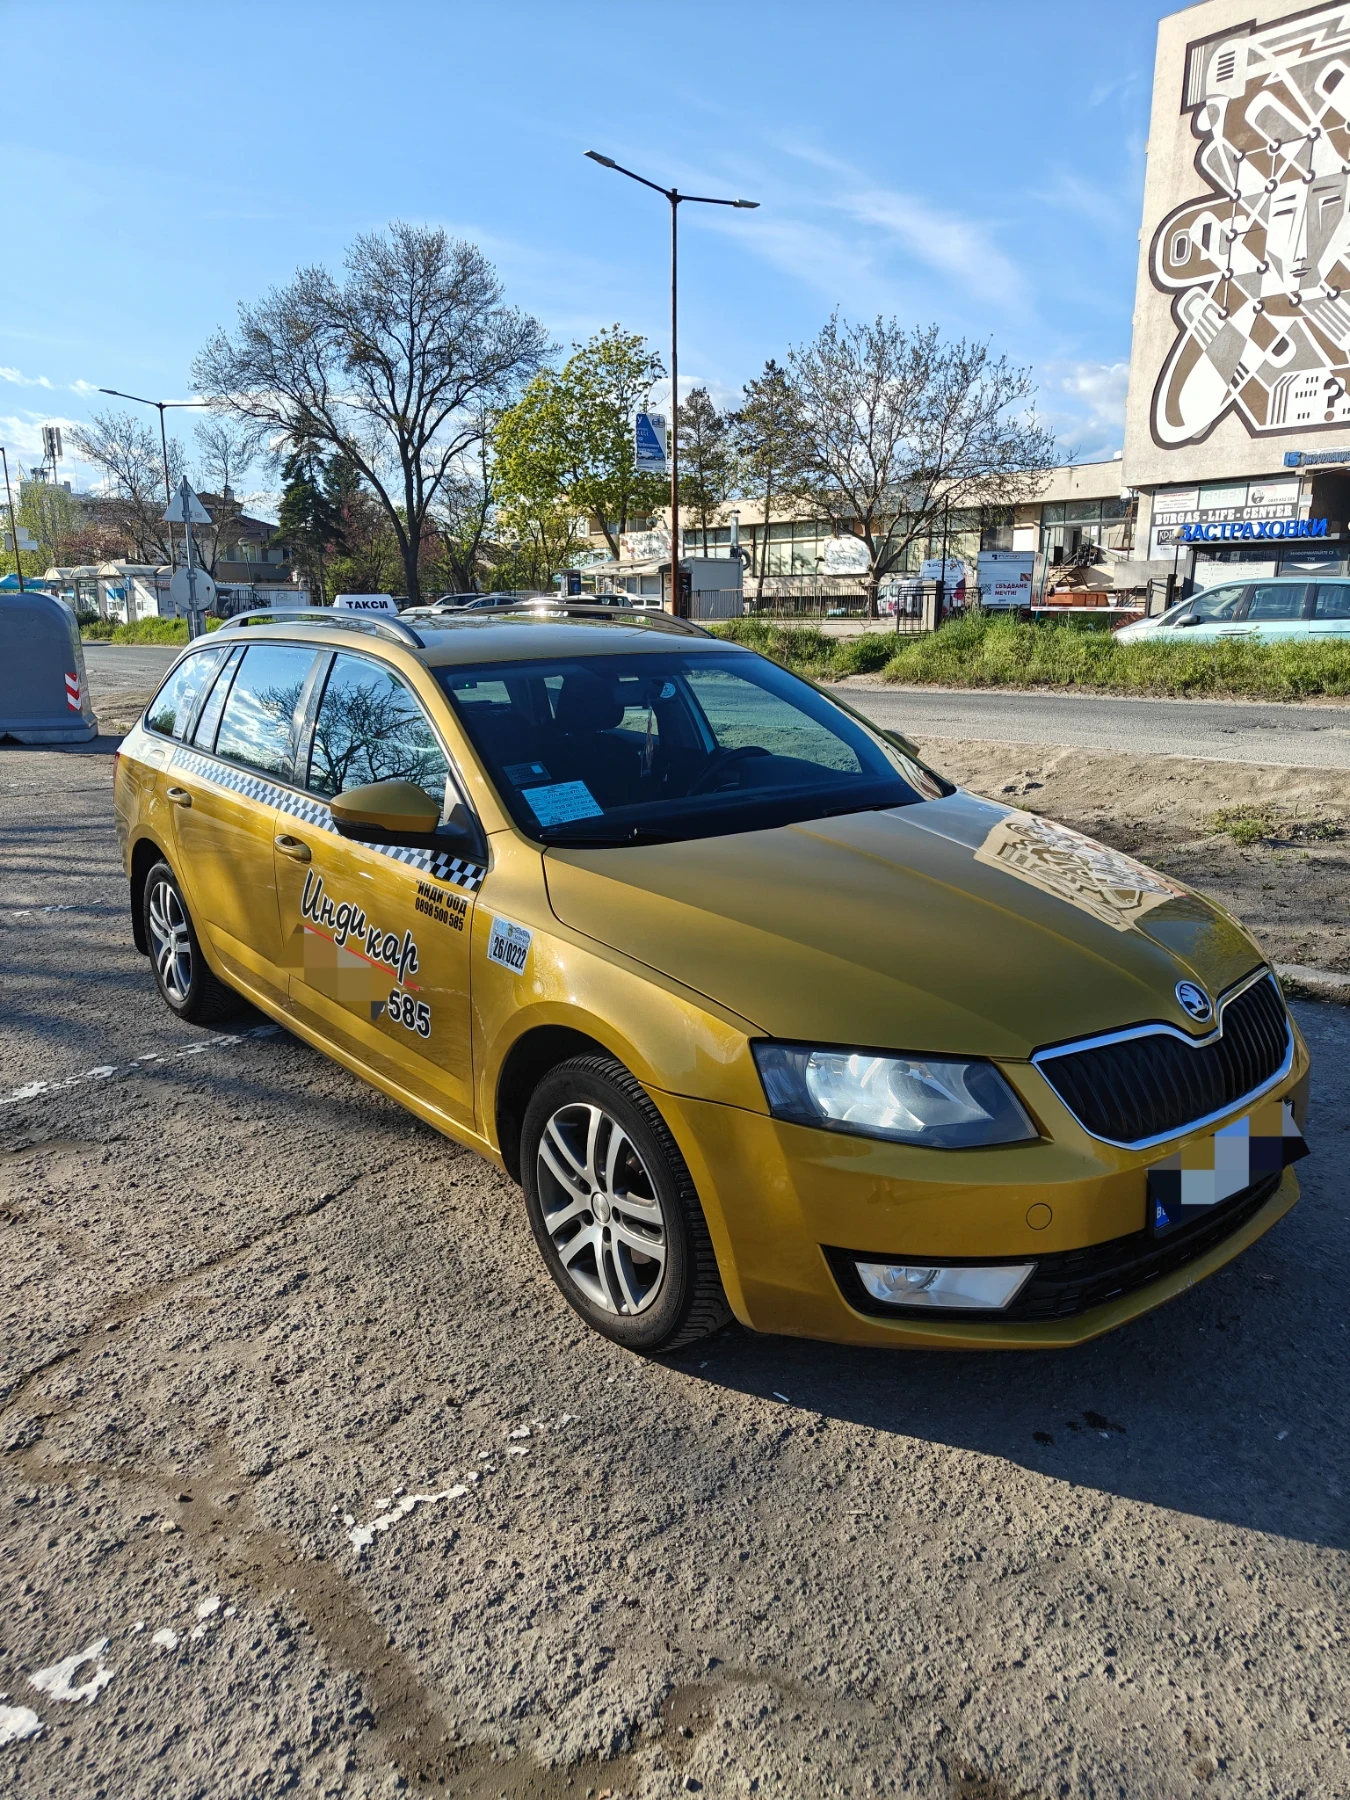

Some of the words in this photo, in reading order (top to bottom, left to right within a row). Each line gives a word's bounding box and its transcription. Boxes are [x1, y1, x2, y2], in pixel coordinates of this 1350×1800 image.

[1155, 511, 1200, 525] BURGAS
[1243, 504, 1292, 519] CENTER
[1180, 518, 1328, 541] ЗАСТРАХОВКИ
[346, 601, 389, 609] ТАКСИ
[415, 897, 433, 917] 0898
[433, 905, 449, 924] 500
[448, 912, 464, 931] 585
[493, 936, 527, 970] 26/0222
[388, 988, 431, 1038] 585
